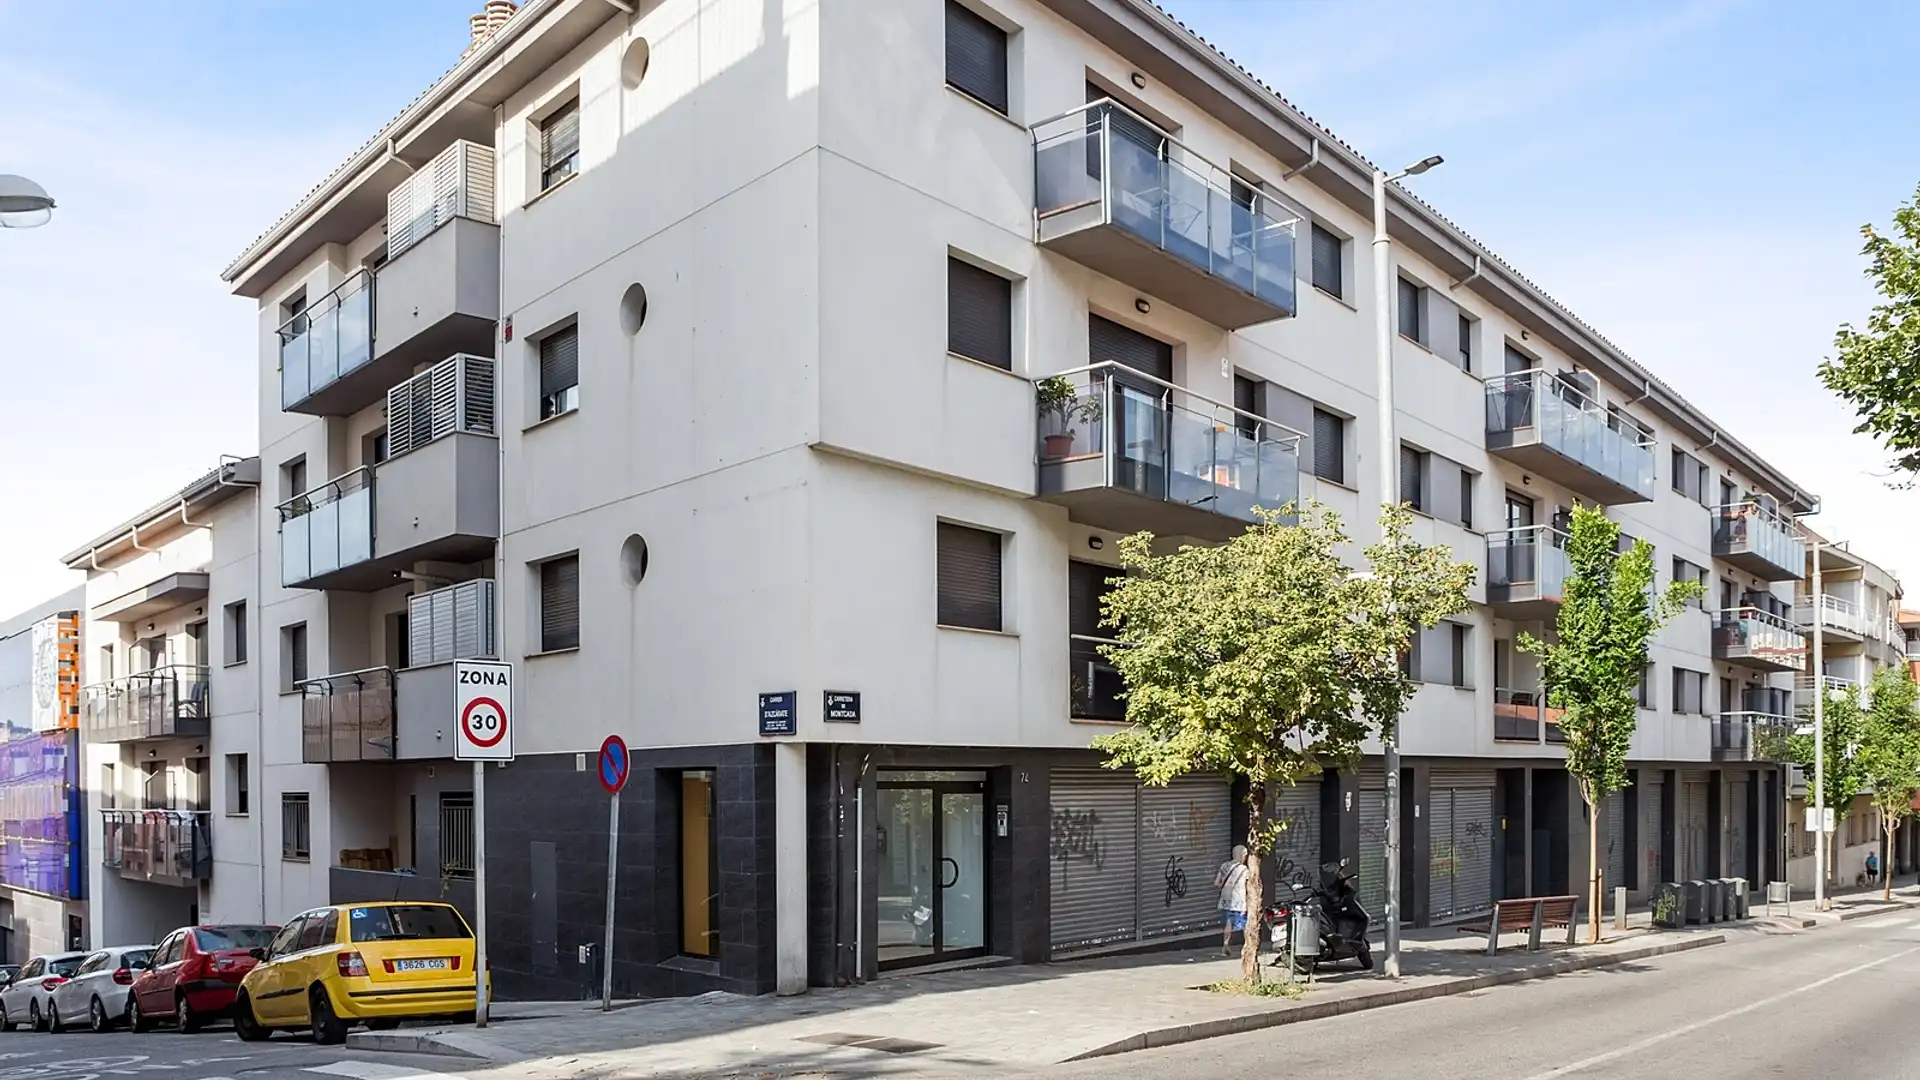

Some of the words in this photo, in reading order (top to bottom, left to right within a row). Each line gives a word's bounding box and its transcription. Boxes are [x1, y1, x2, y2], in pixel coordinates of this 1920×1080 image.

[460, 670, 508, 686] ZONA
[834, 695, 853, 703] CARRETERA
[830, 710, 856, 718] MONTCADA
[472, 714, 497, 730] 30
[403, 960, 425, 970] 3626
[428, 959, 445, 968] CGS
